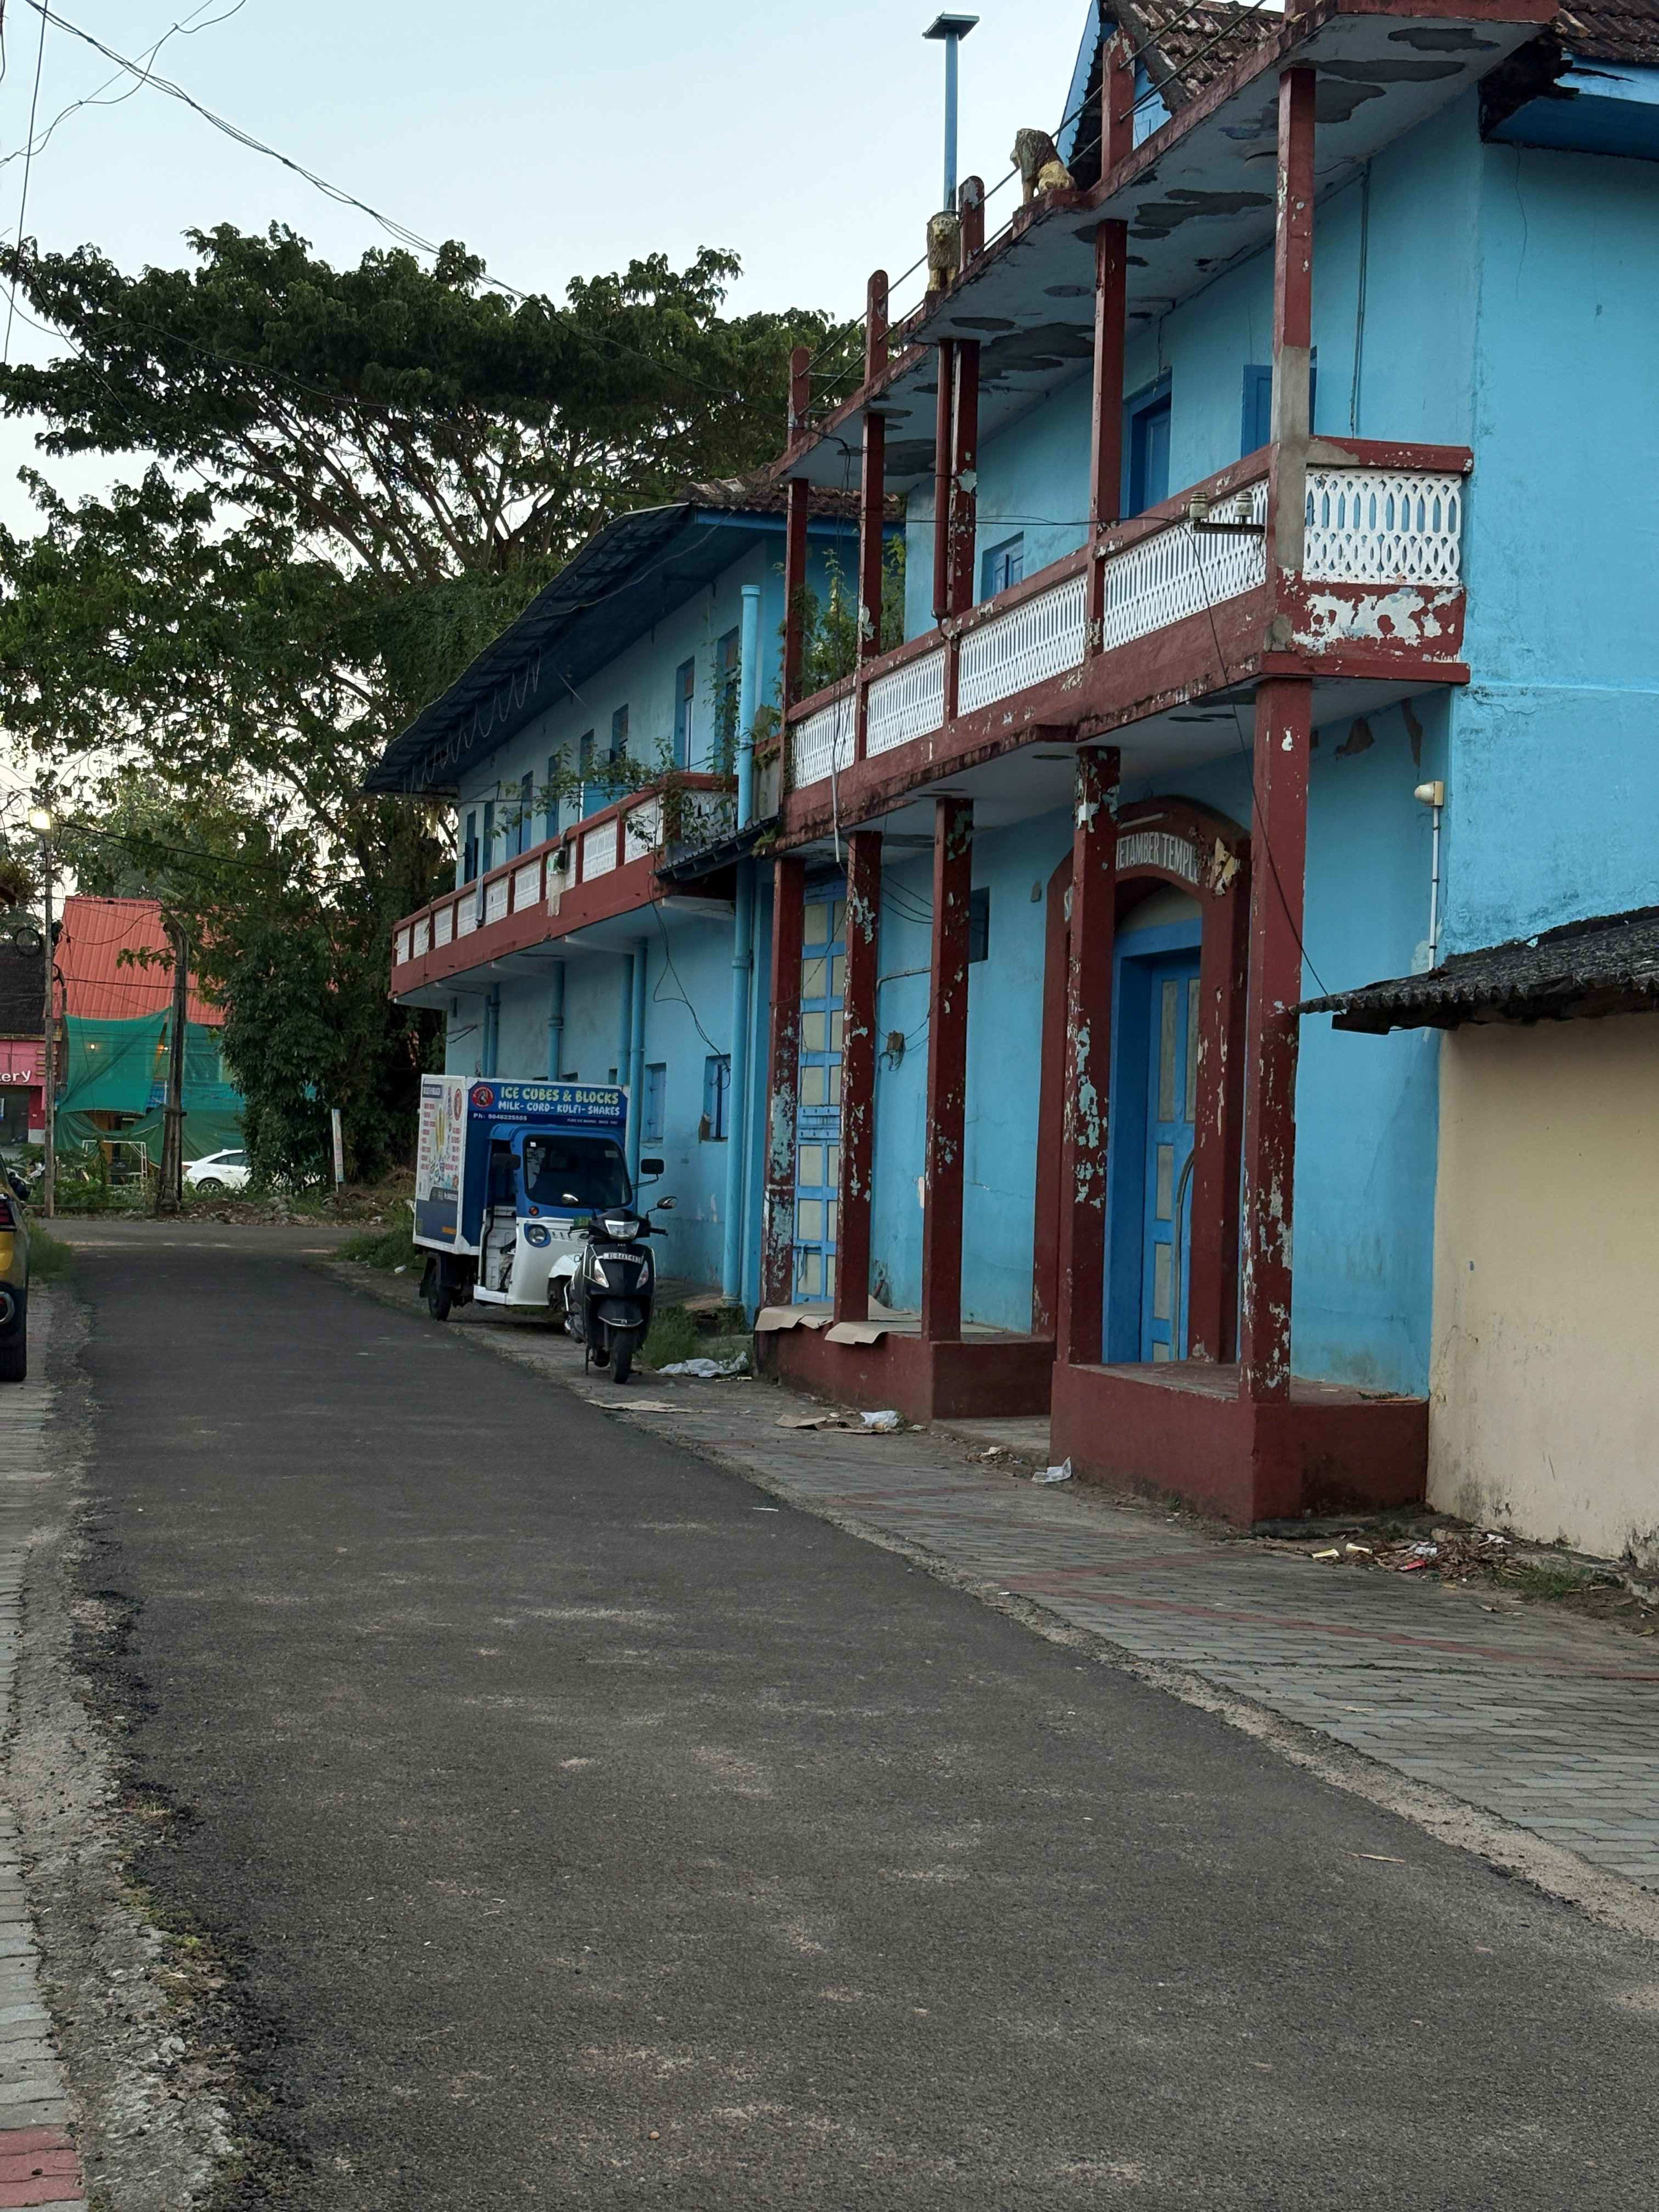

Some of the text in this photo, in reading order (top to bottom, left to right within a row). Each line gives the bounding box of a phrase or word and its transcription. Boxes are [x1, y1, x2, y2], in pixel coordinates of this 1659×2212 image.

[0, 1070, 31, 1083] ery
[501, 1087, 519, 1099] ICE
[522, 1088, 559, 1101] CUBES
[563, 1090, 572, 1102] &
[575, 1090, 619, 1105] BLOCKS
[588, 1105, 620, 1116] SHAKES
